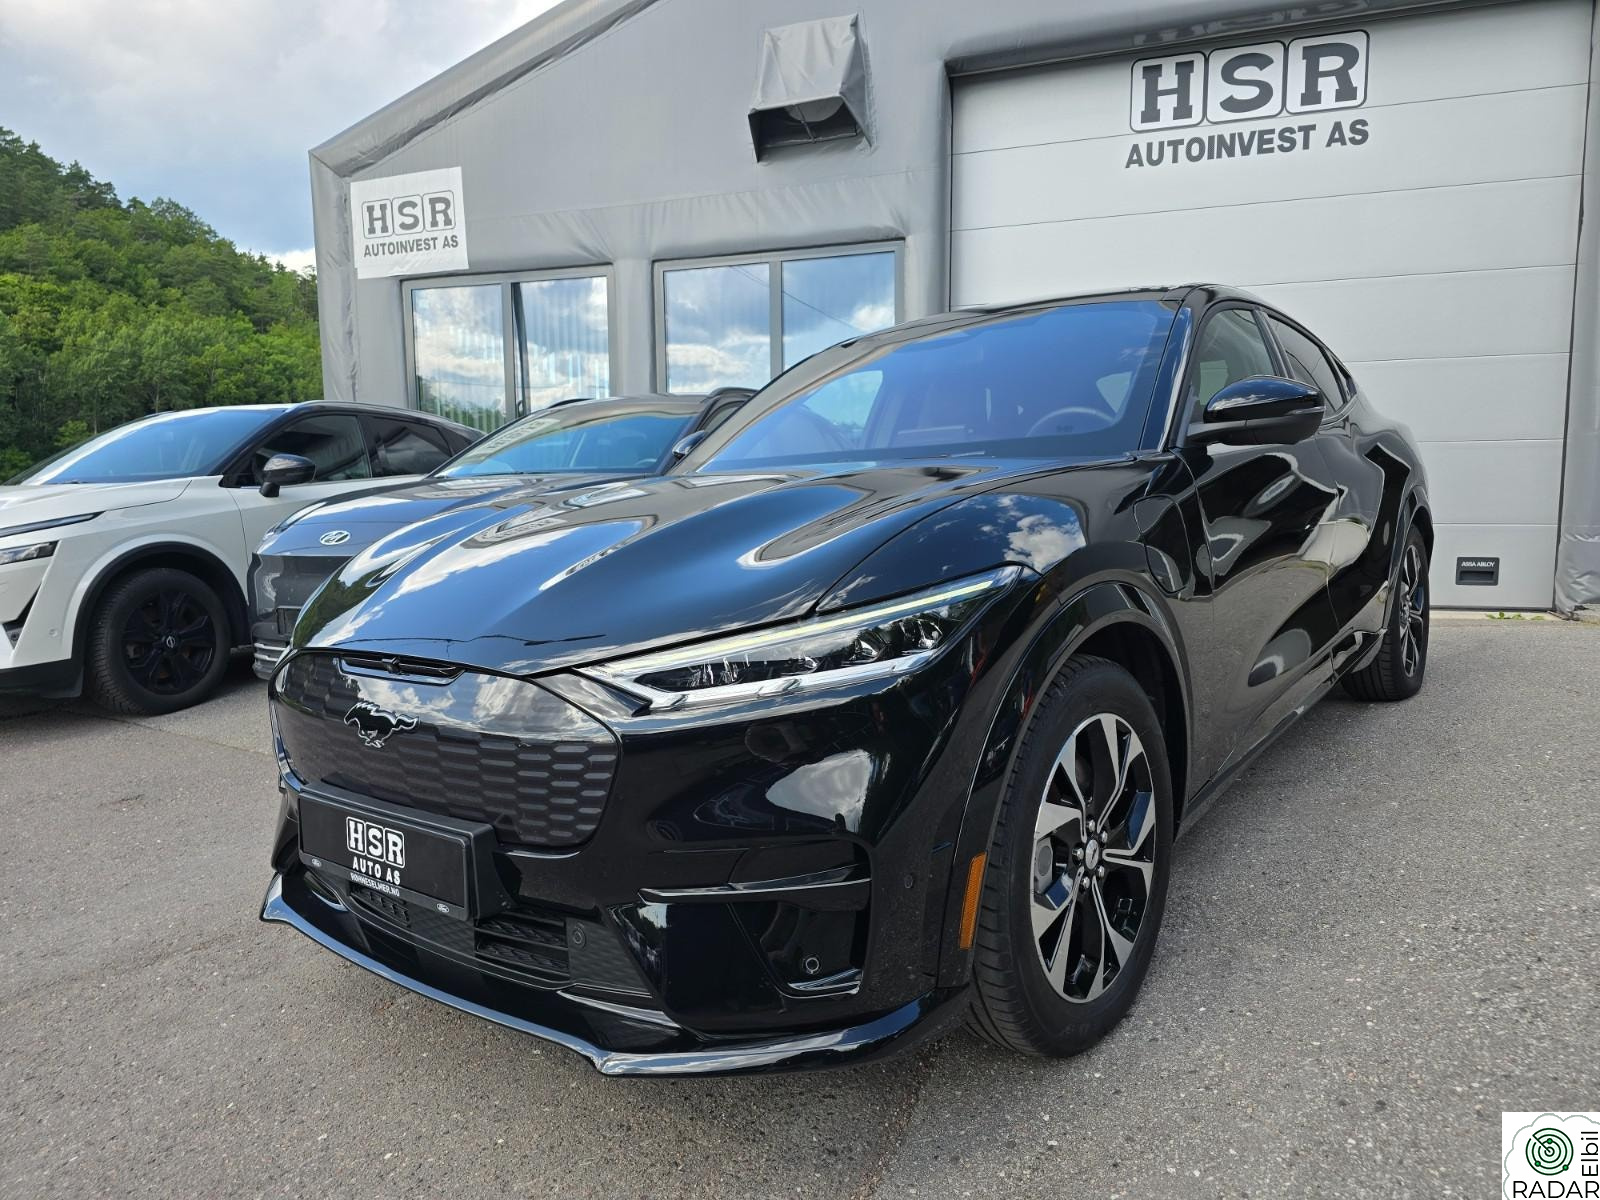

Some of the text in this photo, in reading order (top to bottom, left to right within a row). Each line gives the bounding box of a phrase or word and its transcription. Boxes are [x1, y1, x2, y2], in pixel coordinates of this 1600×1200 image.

[1140, 41, 1360, 124] HSR
[1125, 118, 1369, 168] AUTOINVEST AS
[366, 196, 453, 235] HSR
[363, 234, 459, 258] AUTOINVEST AS
[349, 820, 403, 865] HSR
[352, 856, 401, 885] AUTO AS
